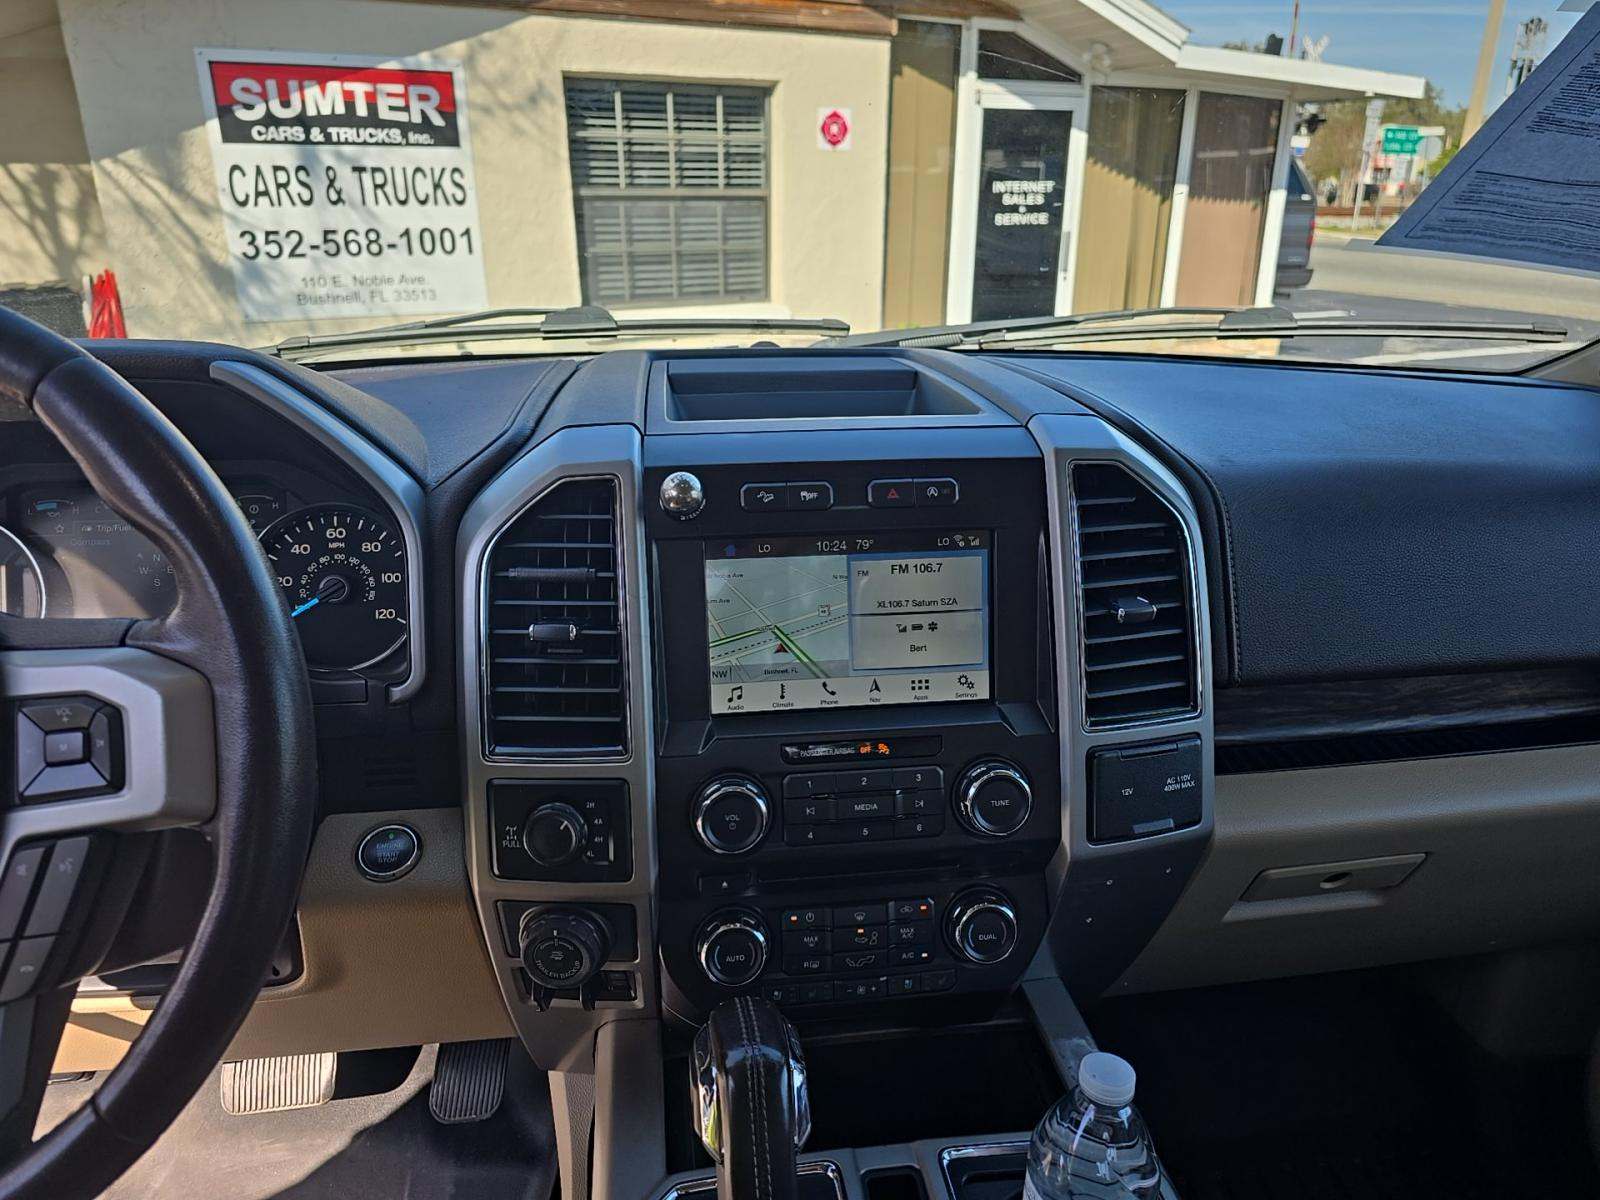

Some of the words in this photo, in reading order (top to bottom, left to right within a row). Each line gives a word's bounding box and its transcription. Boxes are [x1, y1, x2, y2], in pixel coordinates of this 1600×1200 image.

[229, 77, 446, 127] SUMTER
[251, 125, 305, 143] CARS
[309, 127, 325, 143] &
[327, 126, 406, 146] TRUCKS,
[228, 163, 314, 208] CARS
[325, 165, 346, 206] &
[351, 166, 467, 207] TRUCKS
[995, 212, 1049, 226] SERVICE
[238, 227, 474, 261] 352-568-1001
[326, 527, 347, 539] 60
[328, 541, 345, 549] MPH
[816, 540, 848, 552] 10:24
[937, 537, 950, 546] LO
[290, 543, 311, 555] 40
[361, 542, 382, 553] 80
[758, 543, 771, 553] LO
[890, 563, 909, 575] FM
[913, 562, 943, 574] 106.7
[381, 572, 402, 583] 100
[940, 597, 958, 606] SZA
[375, 608, 396, 620] 120
[909, 644, 927, 652] Bert
[712, 669, 728, 678] NW
[955, 691, 978, 699] Settings
[727, 703, 745, 711] Audio
[772, 700, 794, 708] Climate
[860, 745, 872, 753] OFF
[861, 777, 868, 785] 2
[916, 773, 922, 782] 3
[1167, 777, 1176, 785] AC
[808, 780, 814, 788] 1
[1181, 780, 1196, 789] MAX
[1122, 788, 1134, 796] 12V
[854, 803, 878, 811] MEDIA
[991, 799, 1010, 807] TUNE
[807, 831, 814, 839] 4
[862, 828, 869, 836] 5
[726, 955, 745, 963] AUTO
